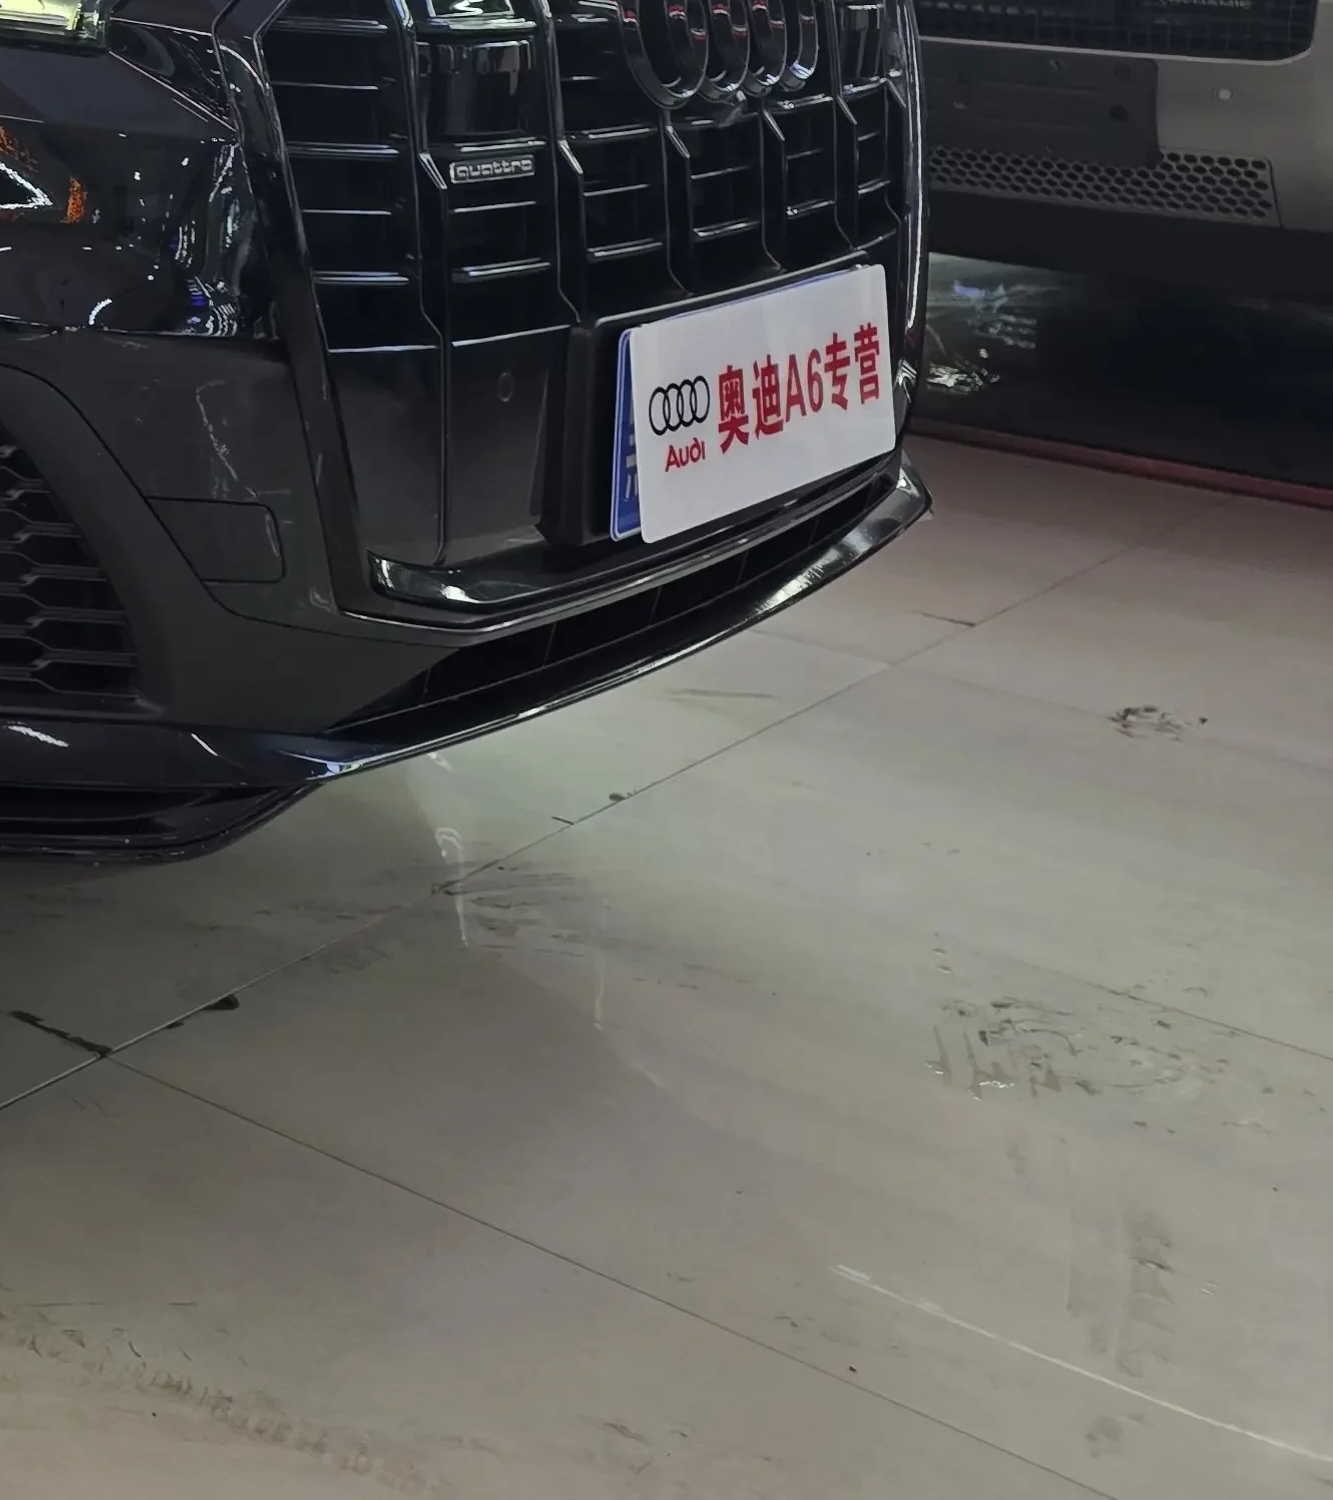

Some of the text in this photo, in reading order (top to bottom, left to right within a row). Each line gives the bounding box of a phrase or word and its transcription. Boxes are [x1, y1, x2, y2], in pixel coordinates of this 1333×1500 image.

[456, 159, 533, 180] quattro
[717, 322, 881, 455] 奥迪A6专营
[664, 436, 706, 473] Audi
